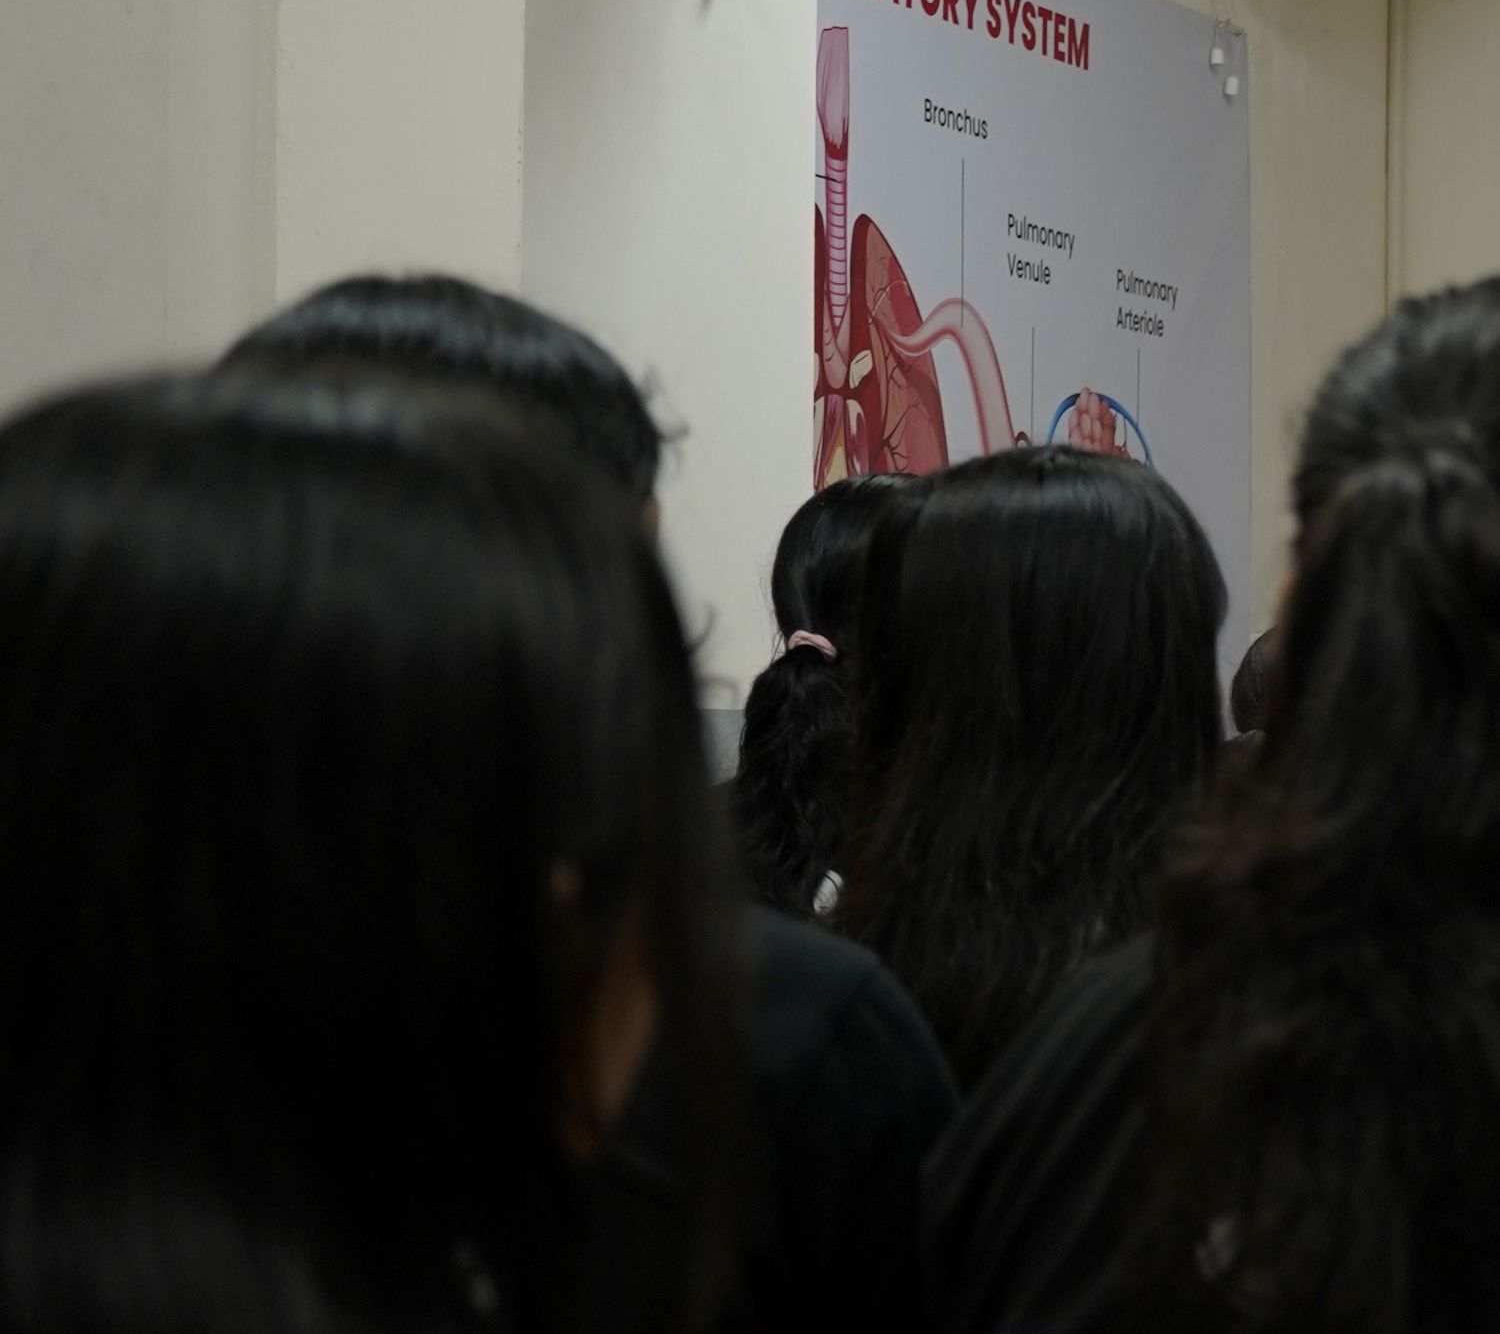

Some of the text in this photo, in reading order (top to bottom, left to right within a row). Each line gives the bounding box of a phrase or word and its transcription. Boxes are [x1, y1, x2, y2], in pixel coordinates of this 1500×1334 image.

[924, 98, 988, 140] Bronchus
[1008, 213, 1075, 259] Pulmonary
[1007, 253, 1051, 285] Venule
[1116, 268, 1178, 312] Pulmonary
[1116, 306, 1164, 337] Arteriole
